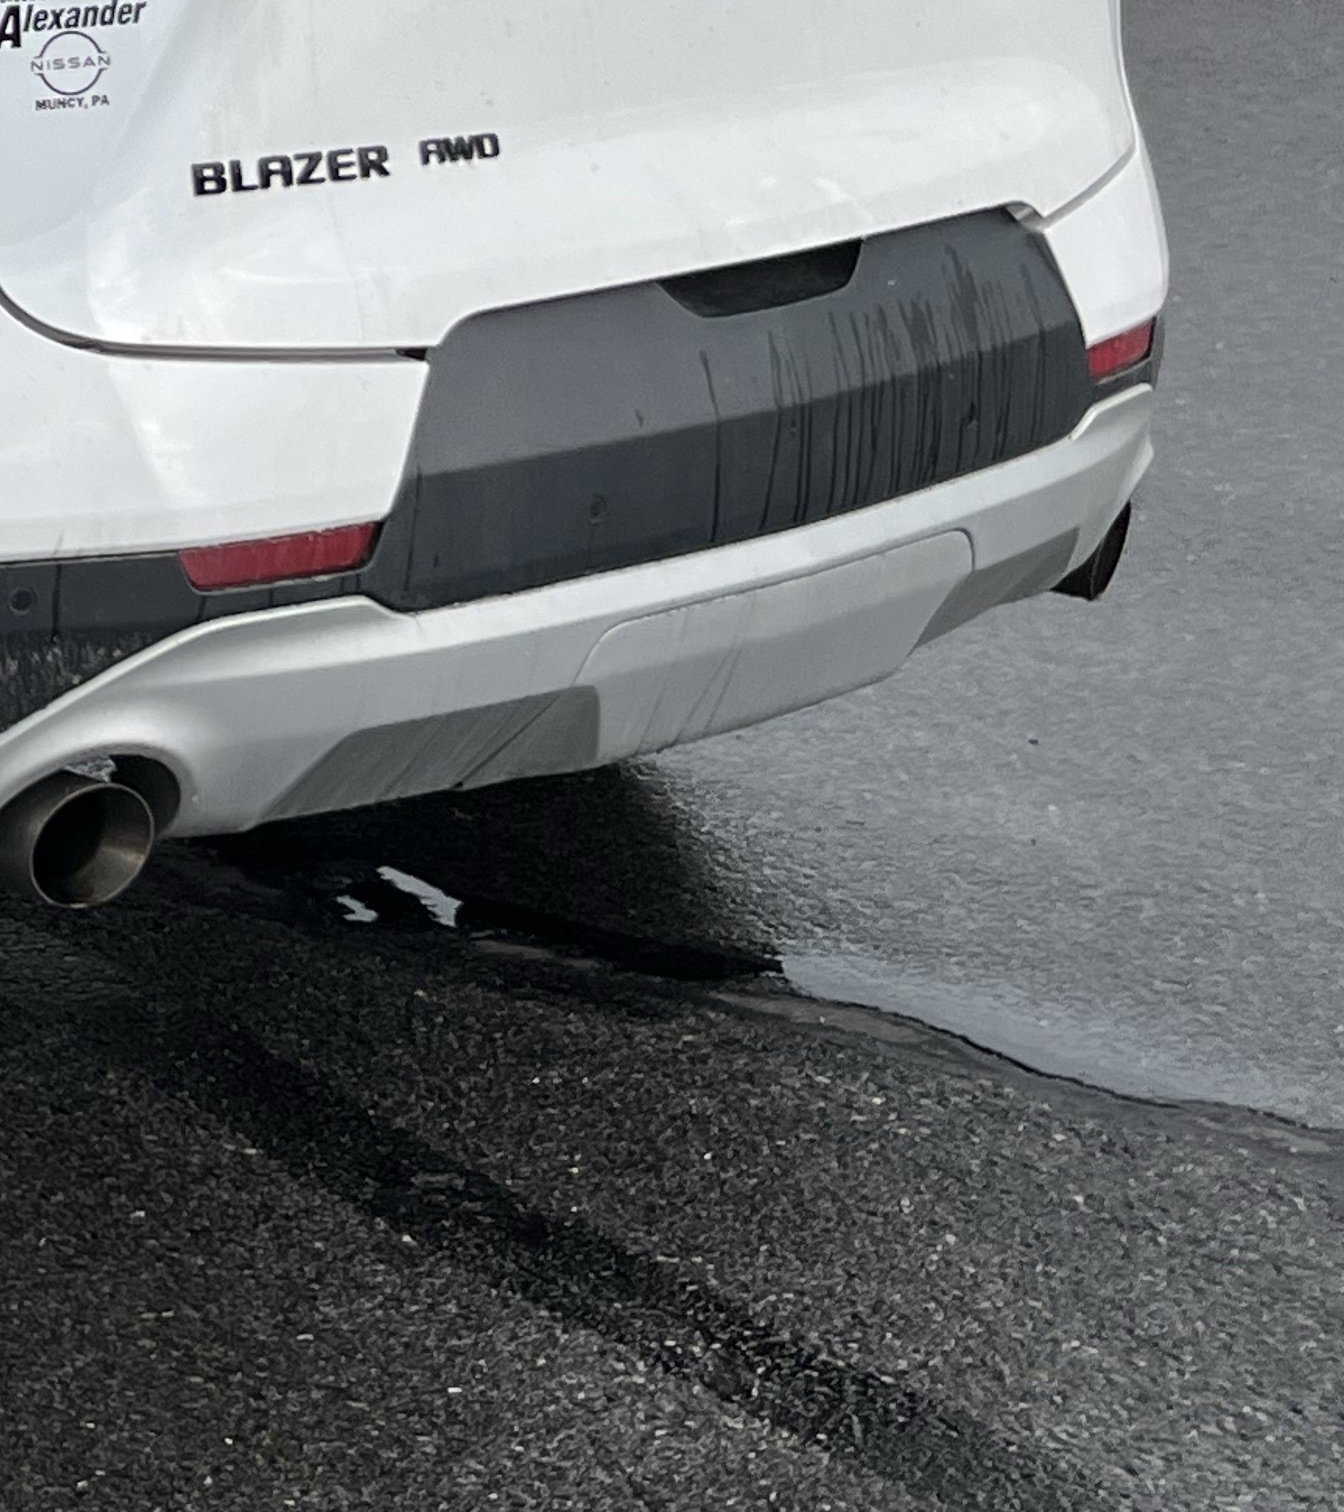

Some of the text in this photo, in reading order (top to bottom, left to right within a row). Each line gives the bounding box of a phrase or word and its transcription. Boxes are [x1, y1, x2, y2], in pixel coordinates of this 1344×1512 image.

[30, 55, 111, 72] NISSAN
[35, 94, 110, 111] MUNCY, PA
[191, 133, 500, 197] BLAZER AWD
